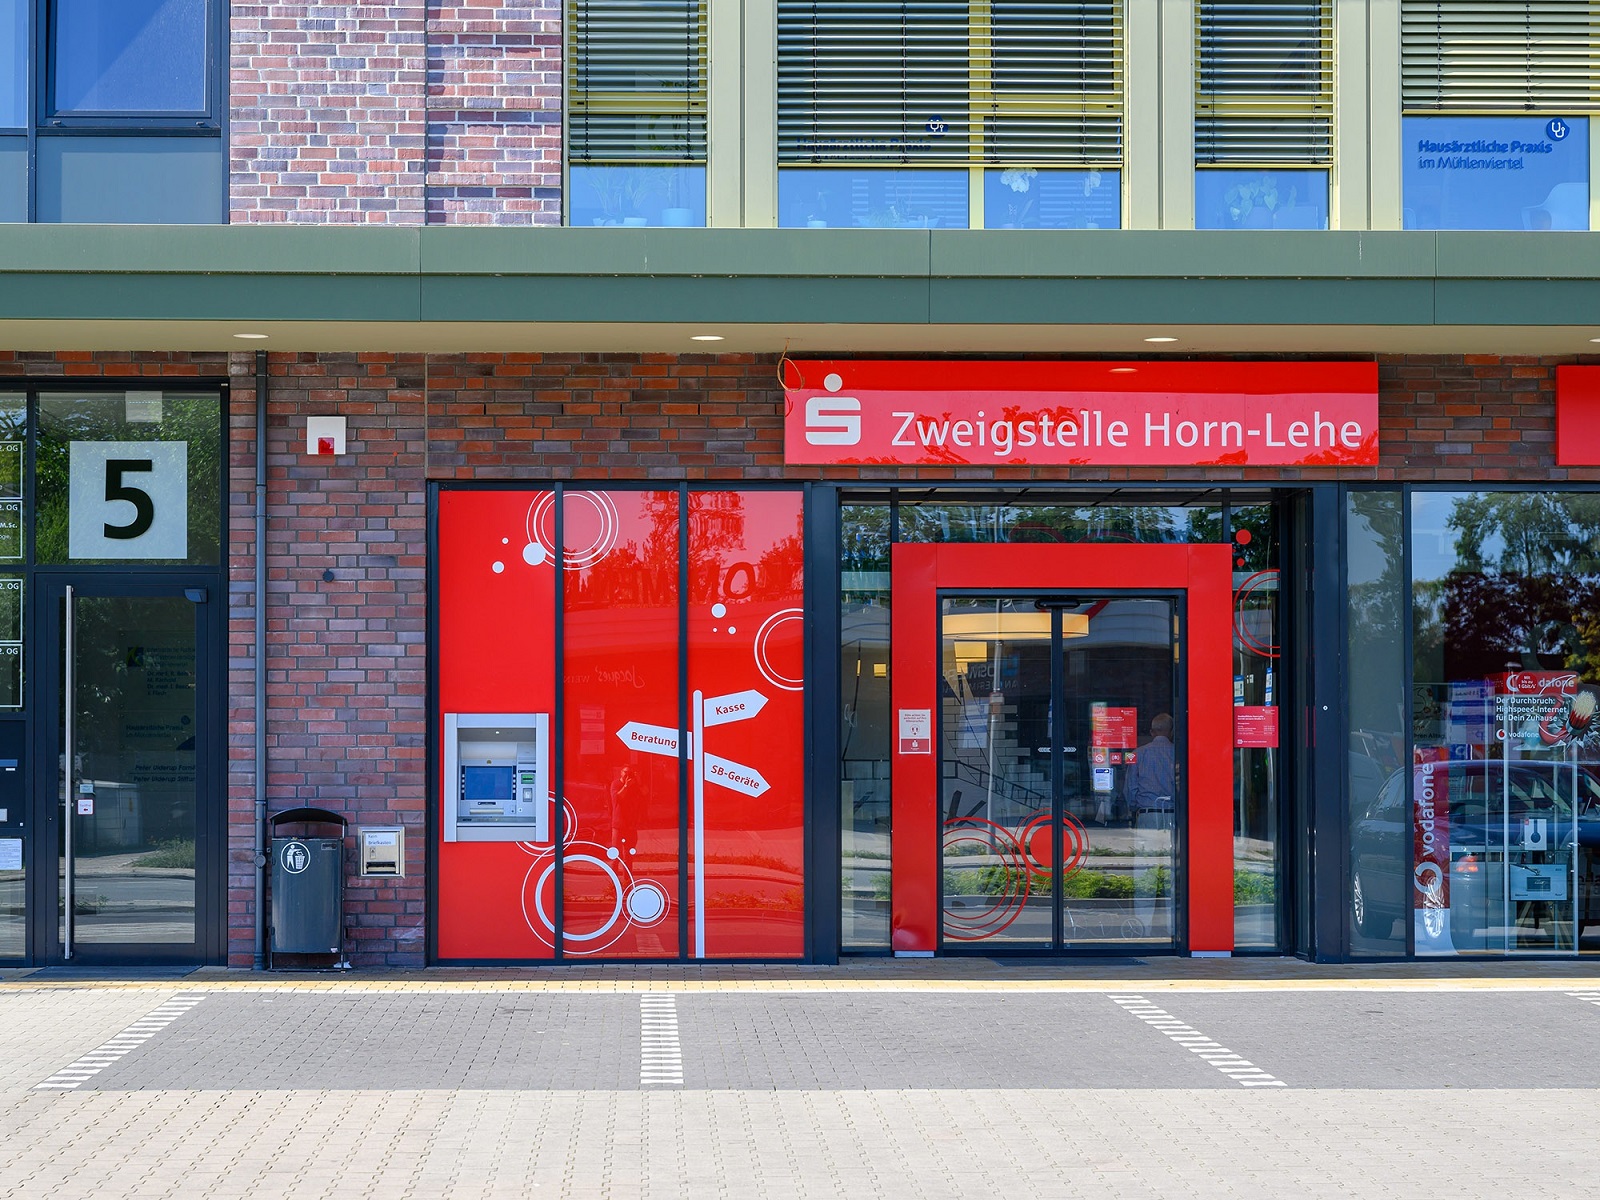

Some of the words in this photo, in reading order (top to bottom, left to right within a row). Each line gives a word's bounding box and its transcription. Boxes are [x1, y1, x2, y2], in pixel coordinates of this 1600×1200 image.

[1418, 140, 1509, 153] Hausärztliche
[1511, 140, 1553, 153] Praxis
[1418, 156, 1435, 169] im
[1437, 156, 1524, 169] Mühlenviertel
[891, 410, 1129, 456] Zweigstelle
[1144, 411, 1363, 447] Horn-Lehe
[6, 444, 18, 452] OG
[103, 459, 154, 540] 5
[7, 582, 19, 590] OG
[6, 647, 18, 655] OG
[715, 702, 746, 715] Kasse
[1496, 706, 1567, 716] Highspeed-Internet
[630, 731, 678, 749] Beratung
[710, 765, 760, 790] SB-Geräte
[1419, 763, 1435, 857] vodafone
